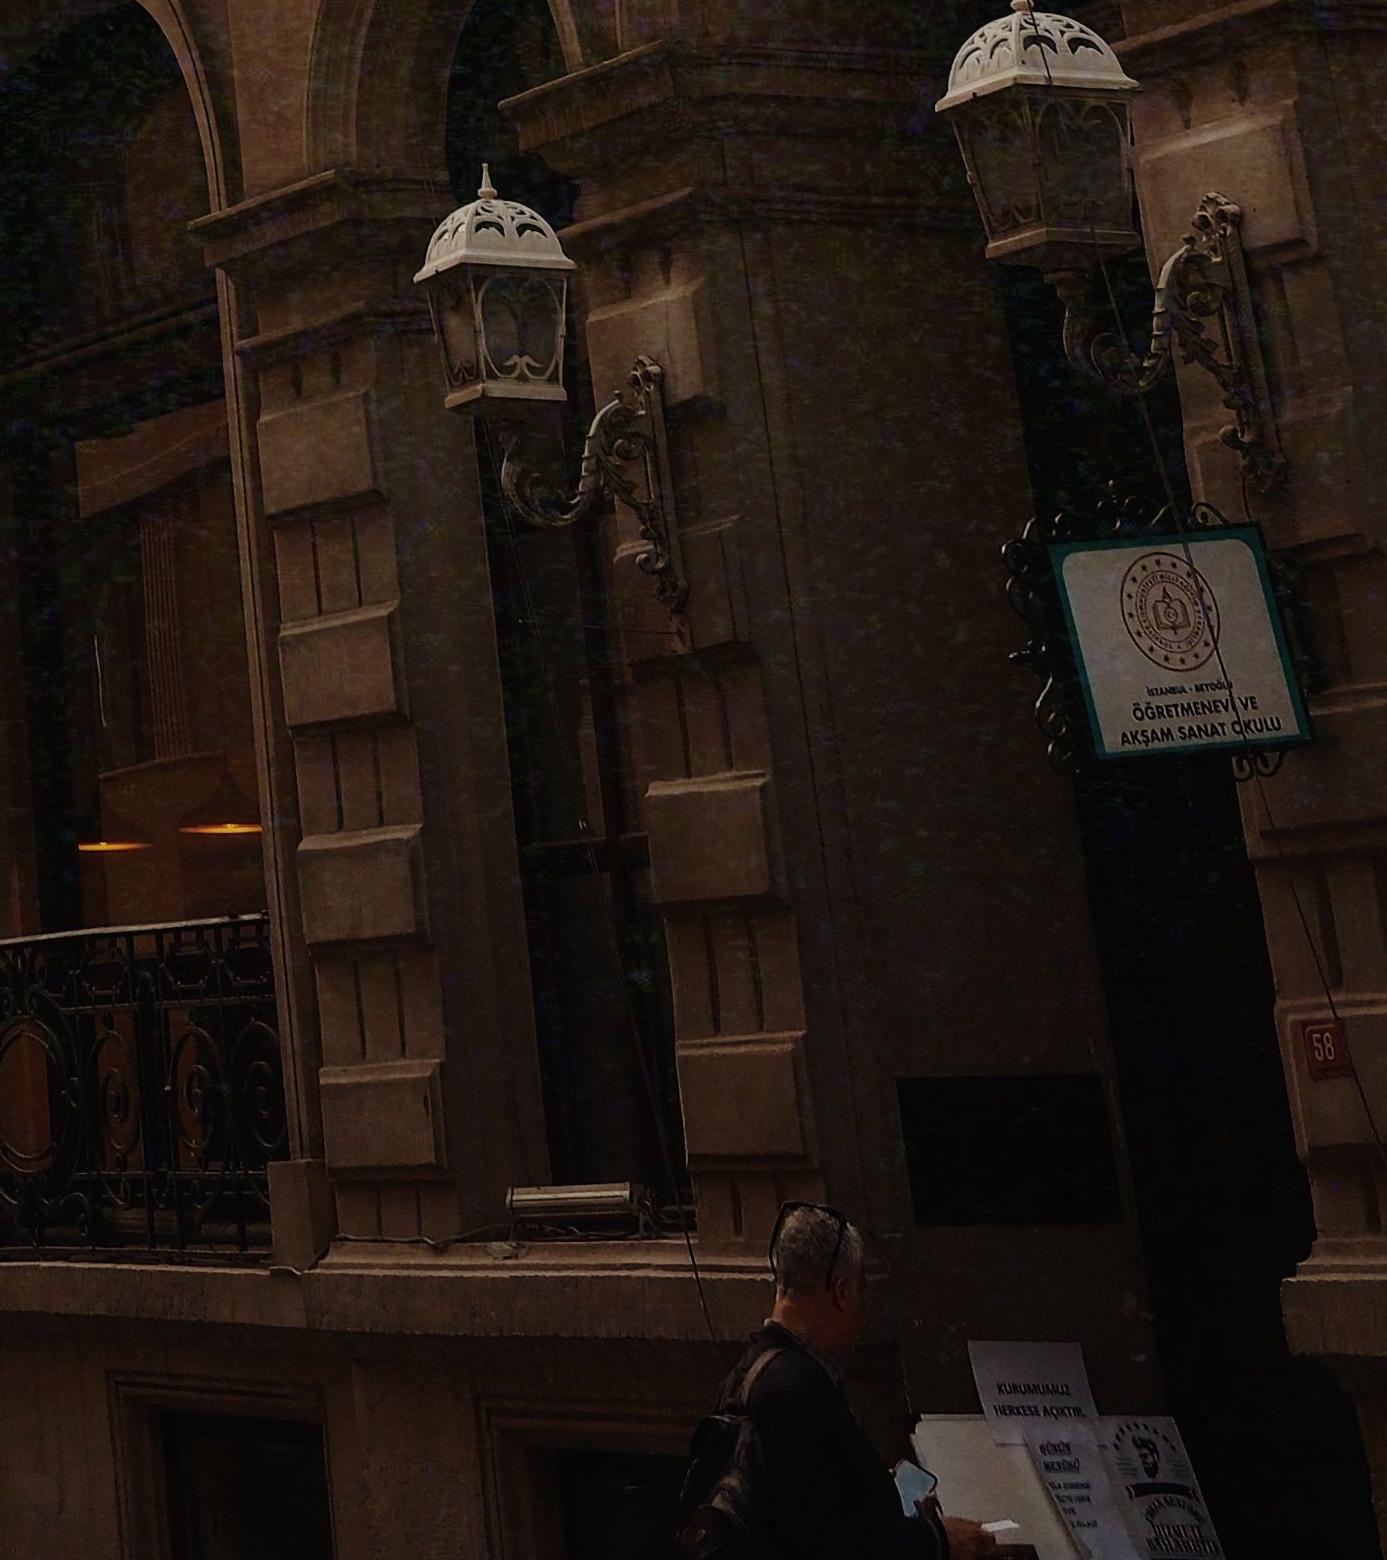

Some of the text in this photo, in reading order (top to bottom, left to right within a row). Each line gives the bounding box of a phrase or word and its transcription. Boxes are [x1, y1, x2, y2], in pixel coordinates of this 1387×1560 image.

[1238, 696, 1259, 711] VE
[1121, 717, 1282, 747] AKŞAM SANAT OKULU
[1312, 1032, 1336, 1061] 58
